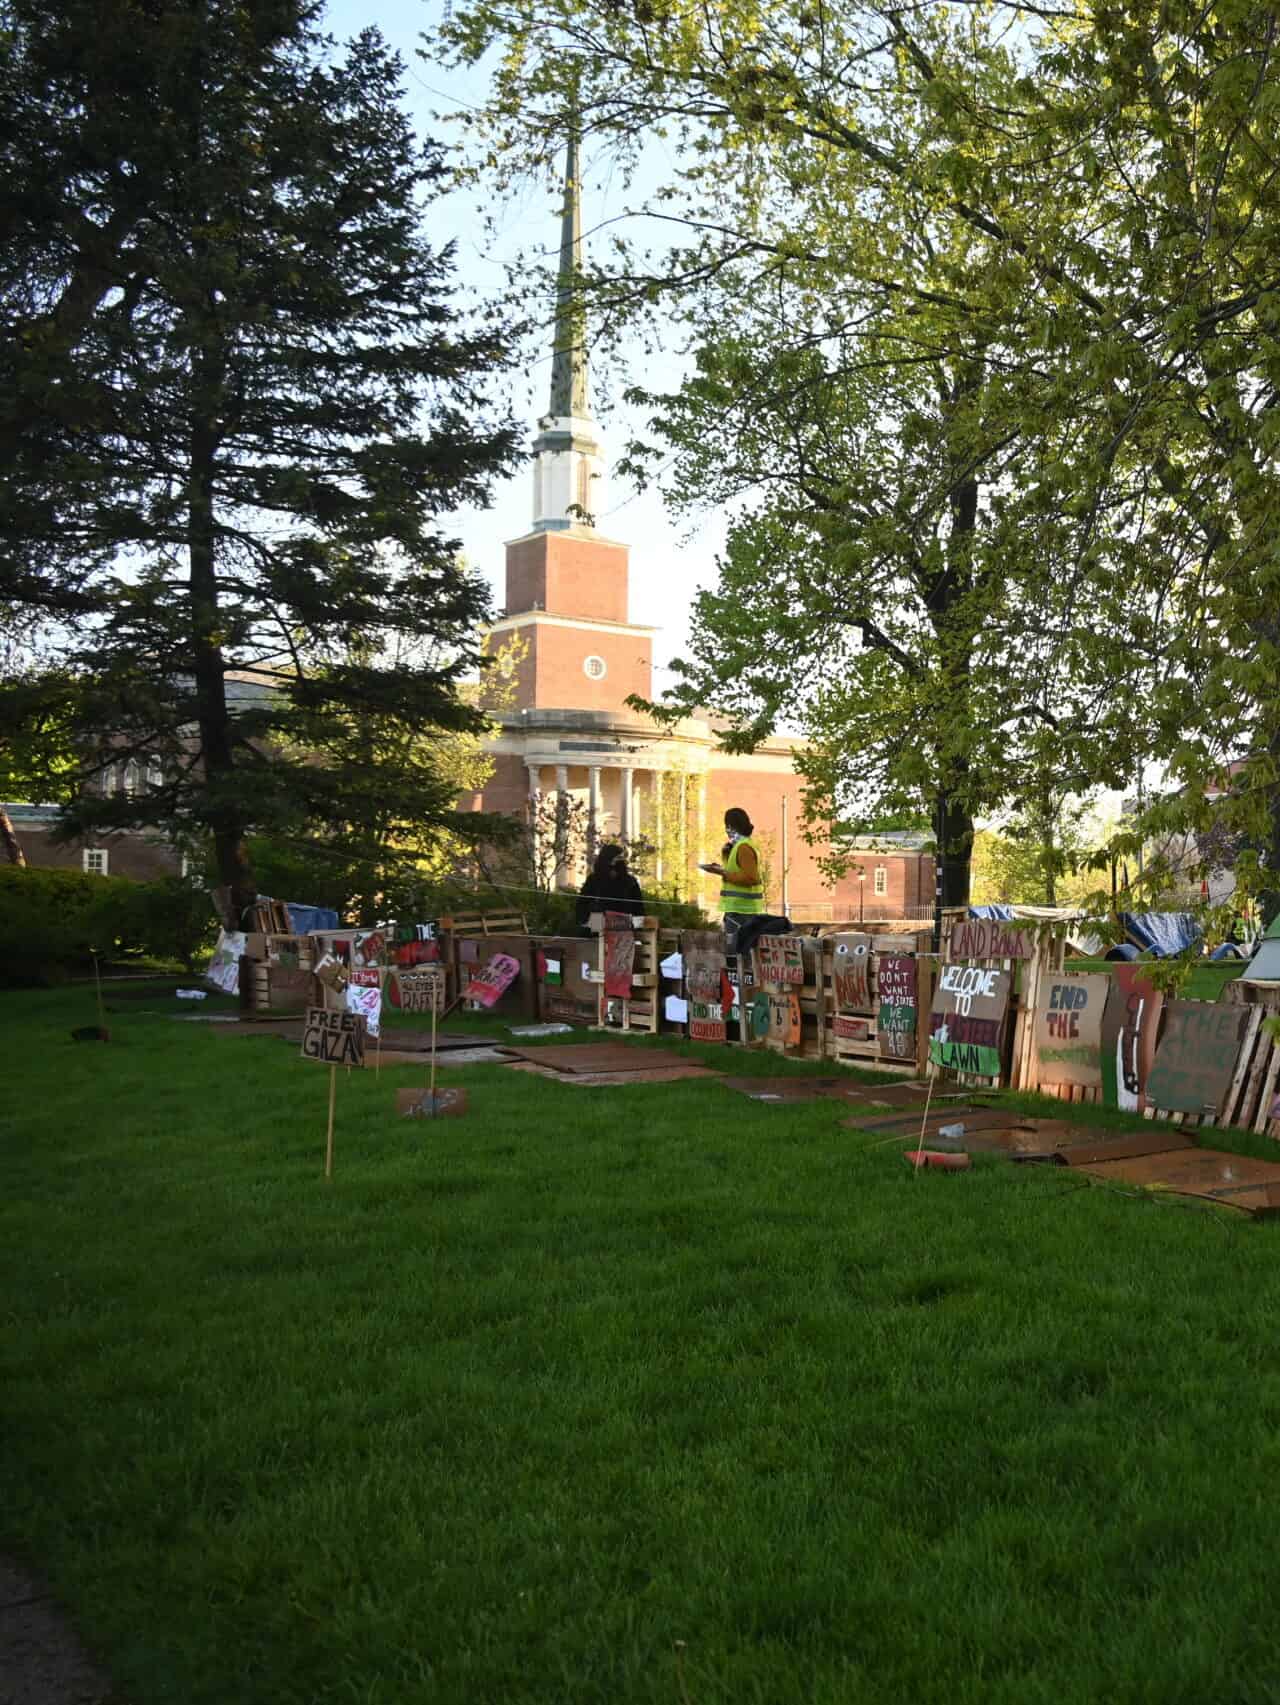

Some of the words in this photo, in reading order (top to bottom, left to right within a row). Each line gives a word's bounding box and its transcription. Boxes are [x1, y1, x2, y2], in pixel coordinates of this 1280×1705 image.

[951, 922, 985, 957] LAND
[888, 959, 901, 970] WE
[416, 982, 433, 991] EYES
[885, 985, 909, 996] WANT
[940, 966, 1001, 997] WELCOME
[880, 995, 895, 1005] TWO
[953, 993, 972, 1017] TO
[1049, 985, 1088, 1009] END
[310, 1010, 354, 1032] FREE
[890, 1007, 902, 1018] WE
[882, 1018, 910, 1032] WANT
[1047, 1012, 1080, 1039] THE
[940, 1044, 979, 1073] LAWN
